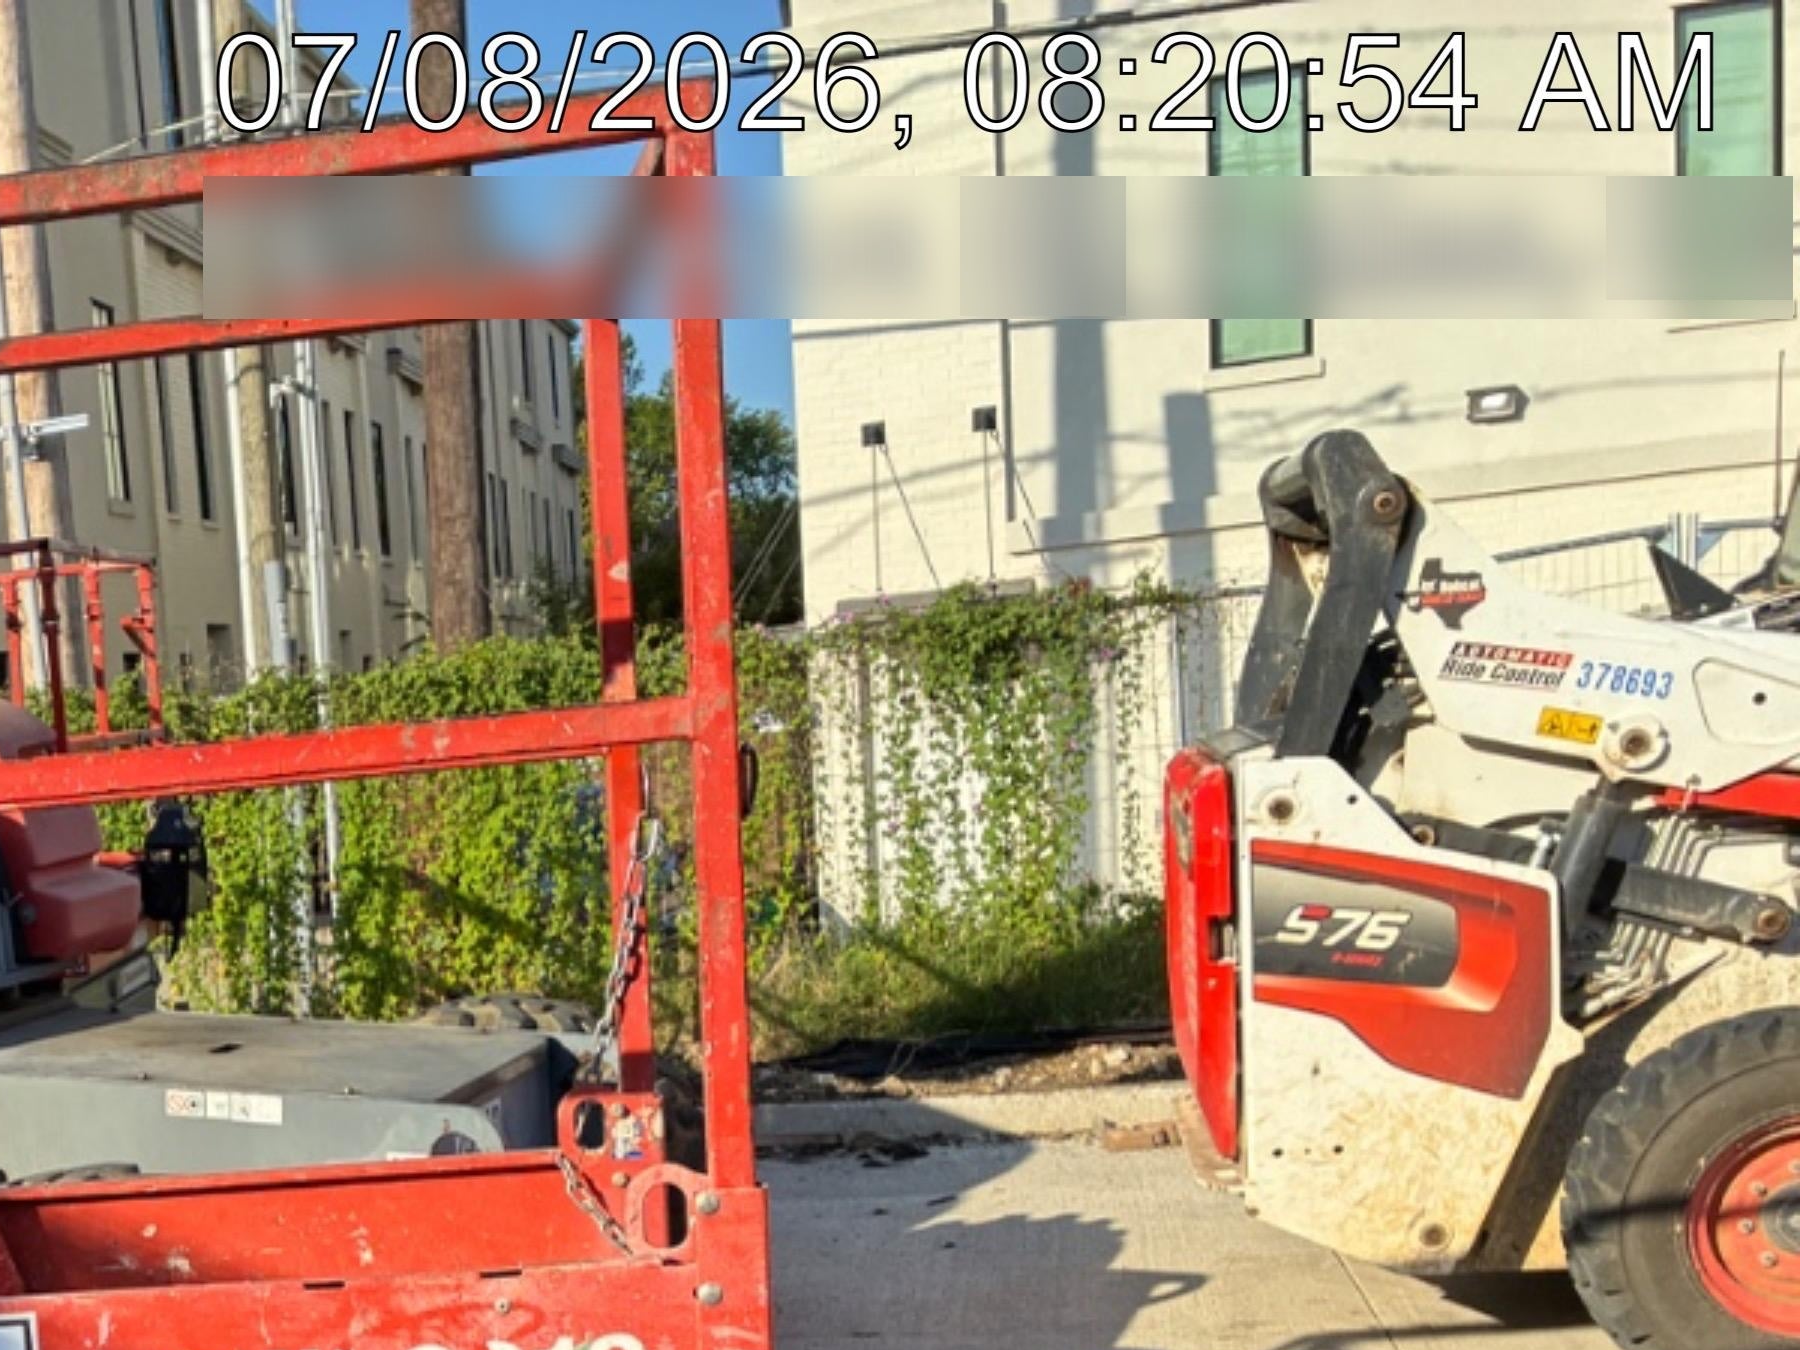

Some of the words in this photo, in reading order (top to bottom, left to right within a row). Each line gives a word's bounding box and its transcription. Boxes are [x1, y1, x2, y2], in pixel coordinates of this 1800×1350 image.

[1442, 659, 1485, 680] Ride
[1490, 663, 1567, 689] Control
[1576, 660, 1674, 700] 378693
[1274, 904, 1413, 950] S76
